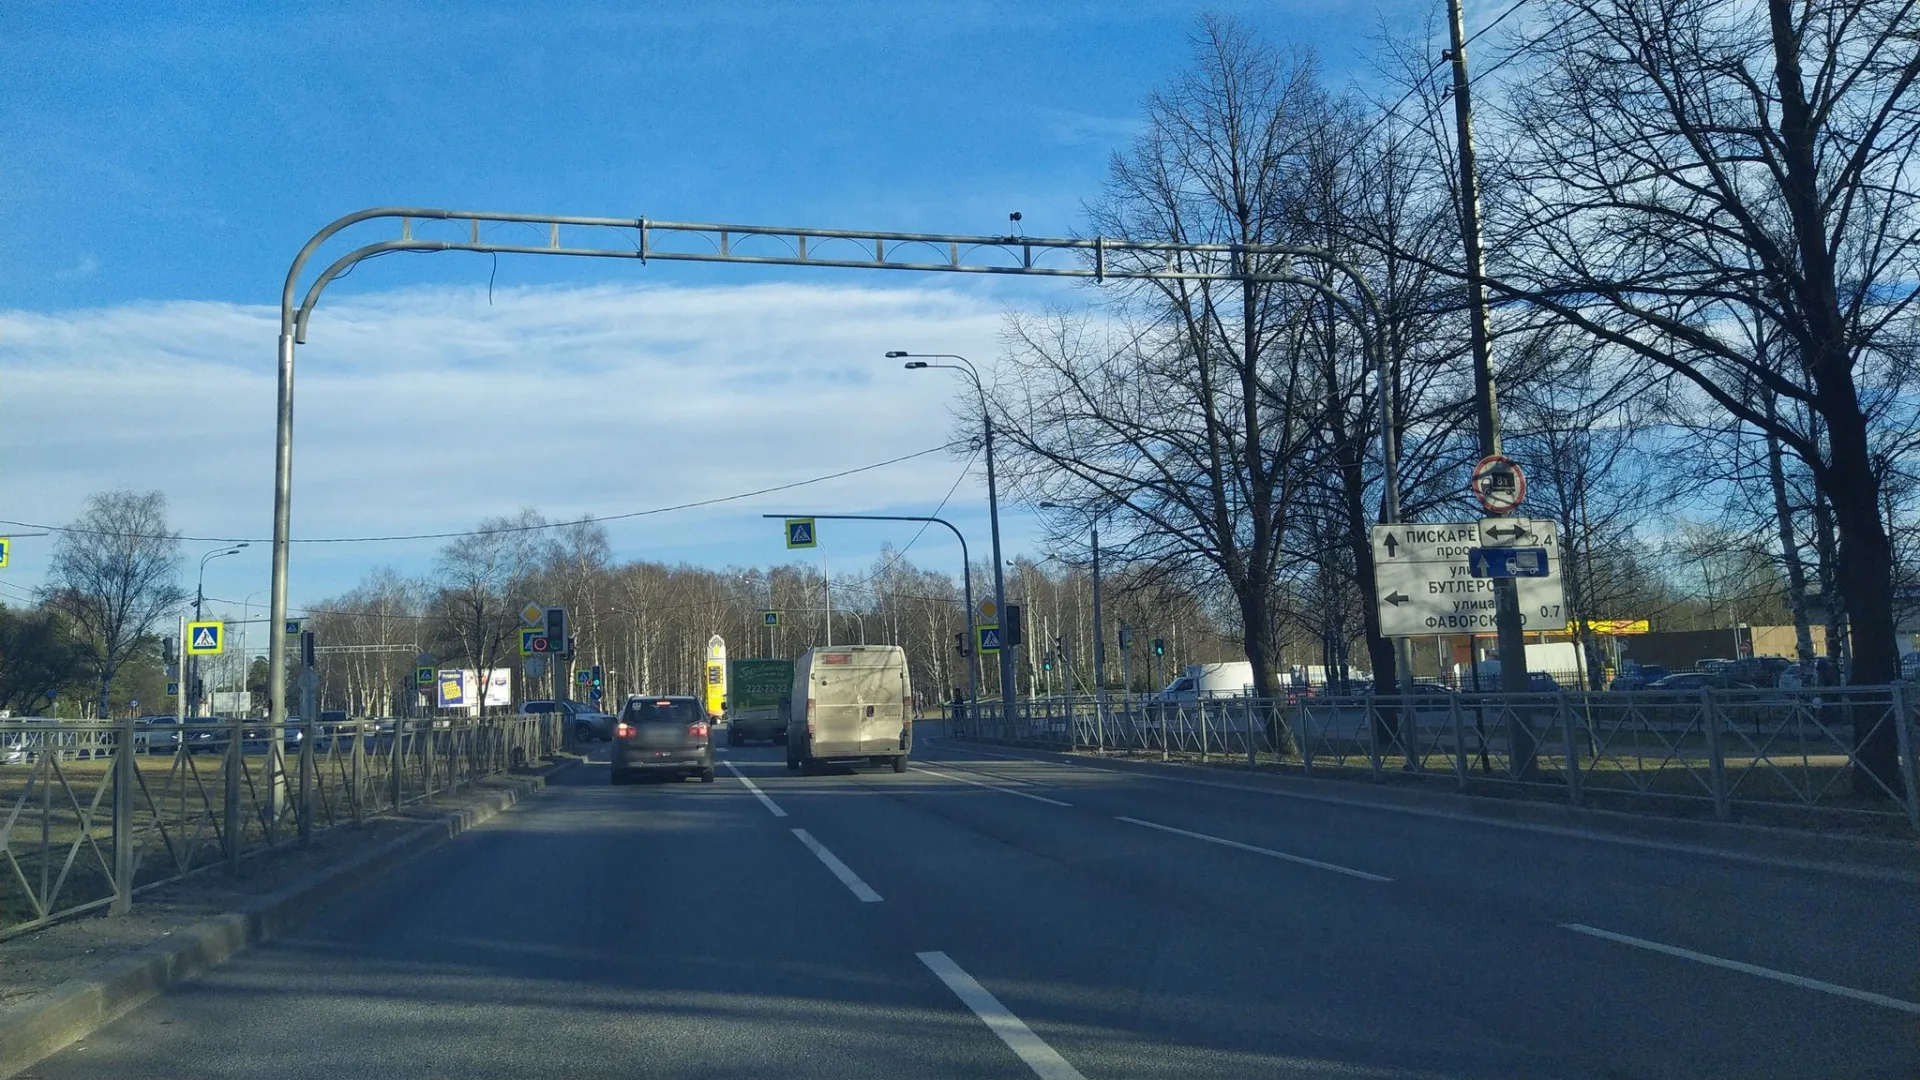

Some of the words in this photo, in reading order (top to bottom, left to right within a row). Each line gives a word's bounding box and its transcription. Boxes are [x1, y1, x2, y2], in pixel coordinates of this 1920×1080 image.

[1406, 526, 1477, 543] ПИСКАРЁ
[1532, 534, 1553, 547] 2.4
[1437, 546, 1470, 559] прос
[1428, 580, 1495, 594] БУТЛЕРО
[1453, 599, 1496, 613] улица
[1425, 613, 1527, 629] ФАВОРСКО
[1540, 605, 1560, 618] 0.7
[746, 684, 788, 693] 222-22-22
